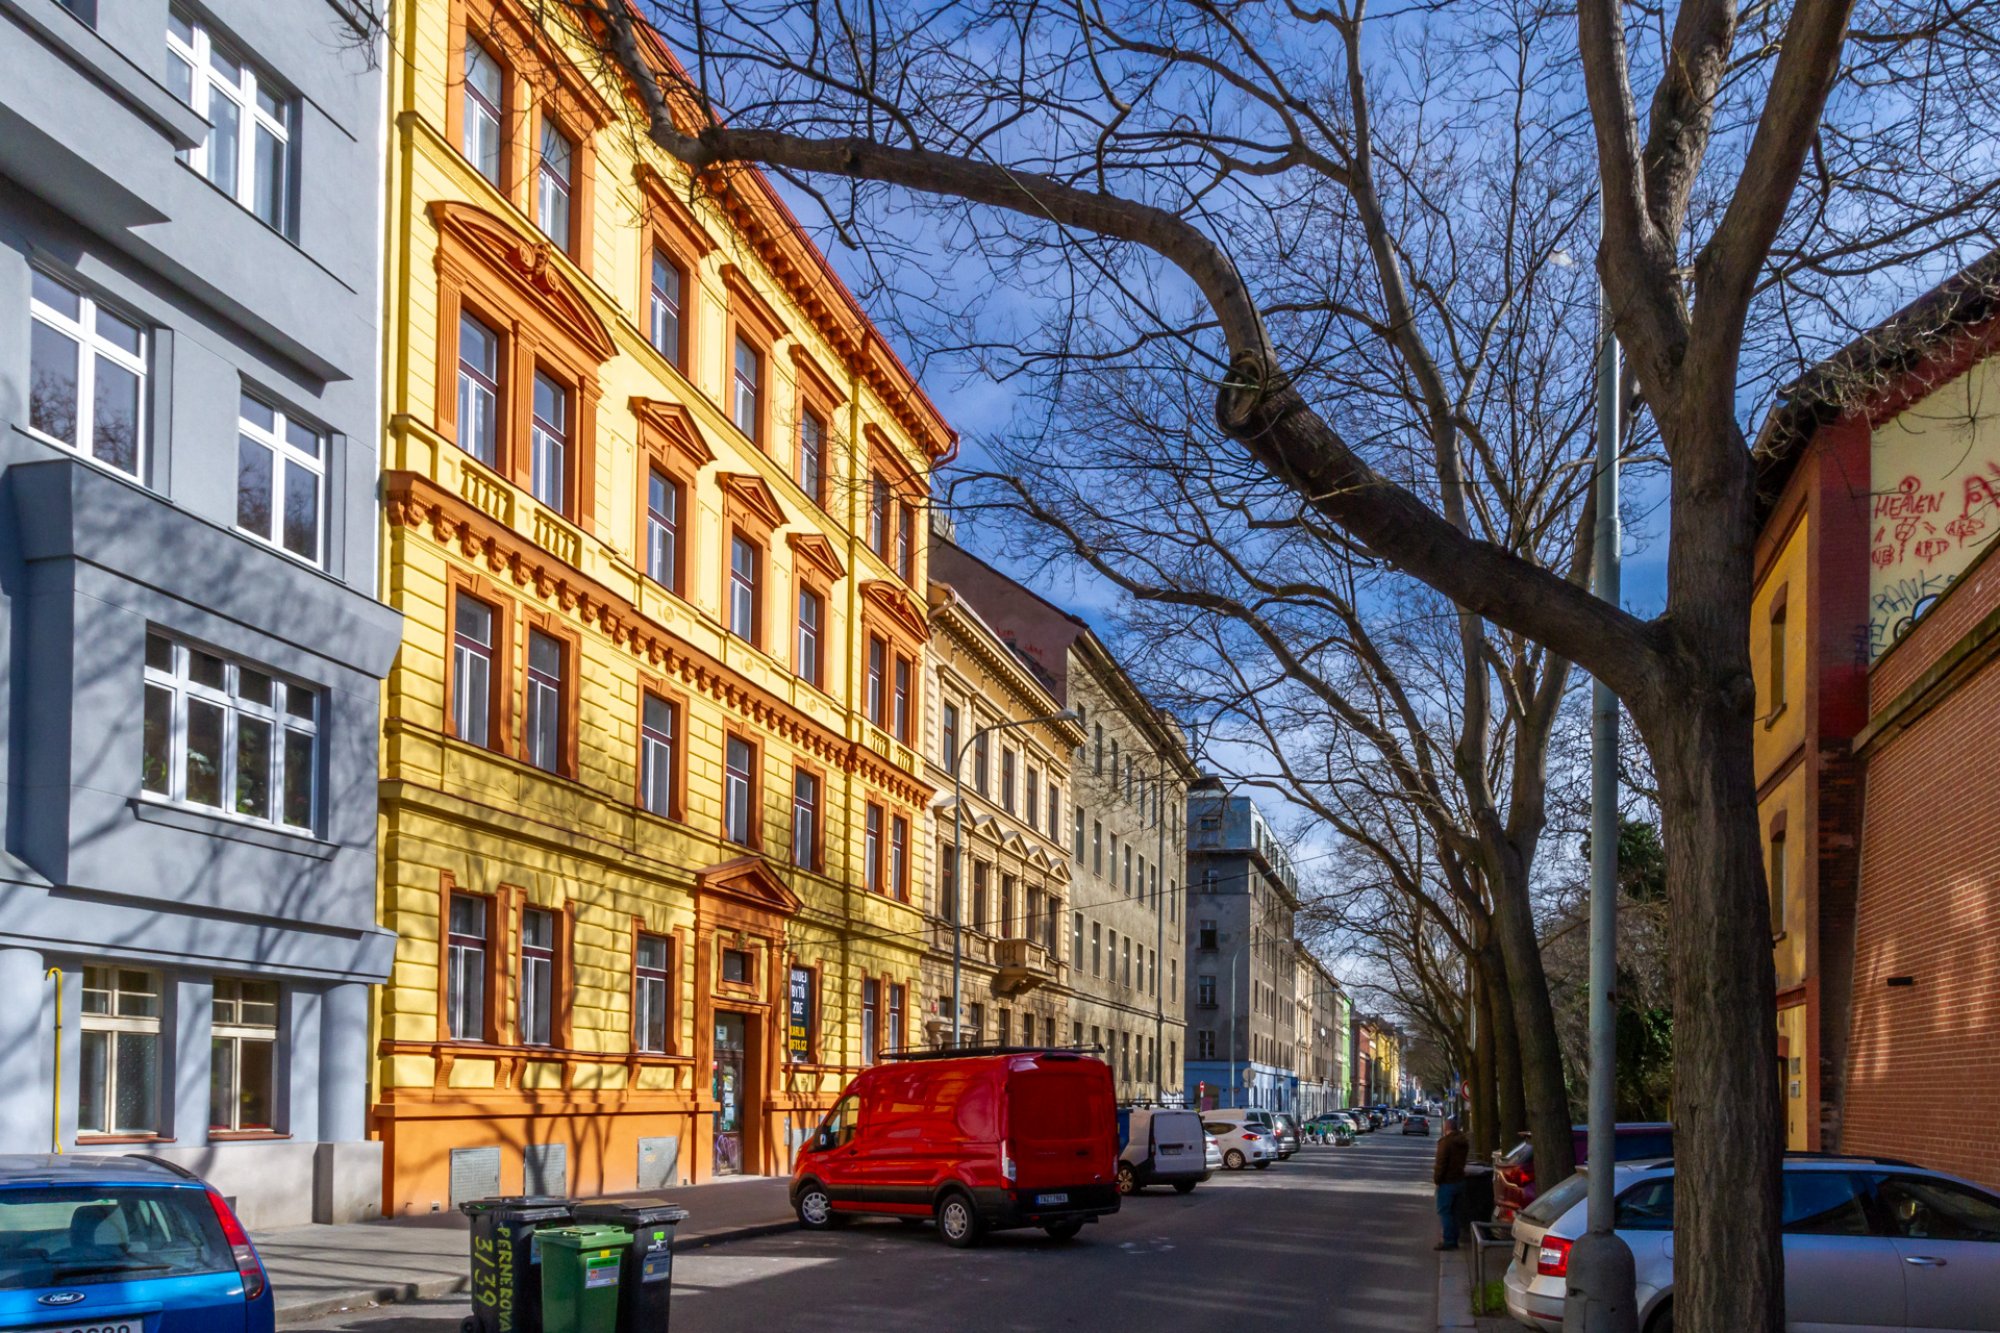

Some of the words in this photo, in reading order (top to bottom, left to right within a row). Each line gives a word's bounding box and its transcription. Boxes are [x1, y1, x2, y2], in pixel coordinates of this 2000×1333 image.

[792, 1001, 804, 1015] ZDE
[791, 1040, 807, 1051] OFTS.CZ
[497, 1227, 513, 1332] PERNEROVA
